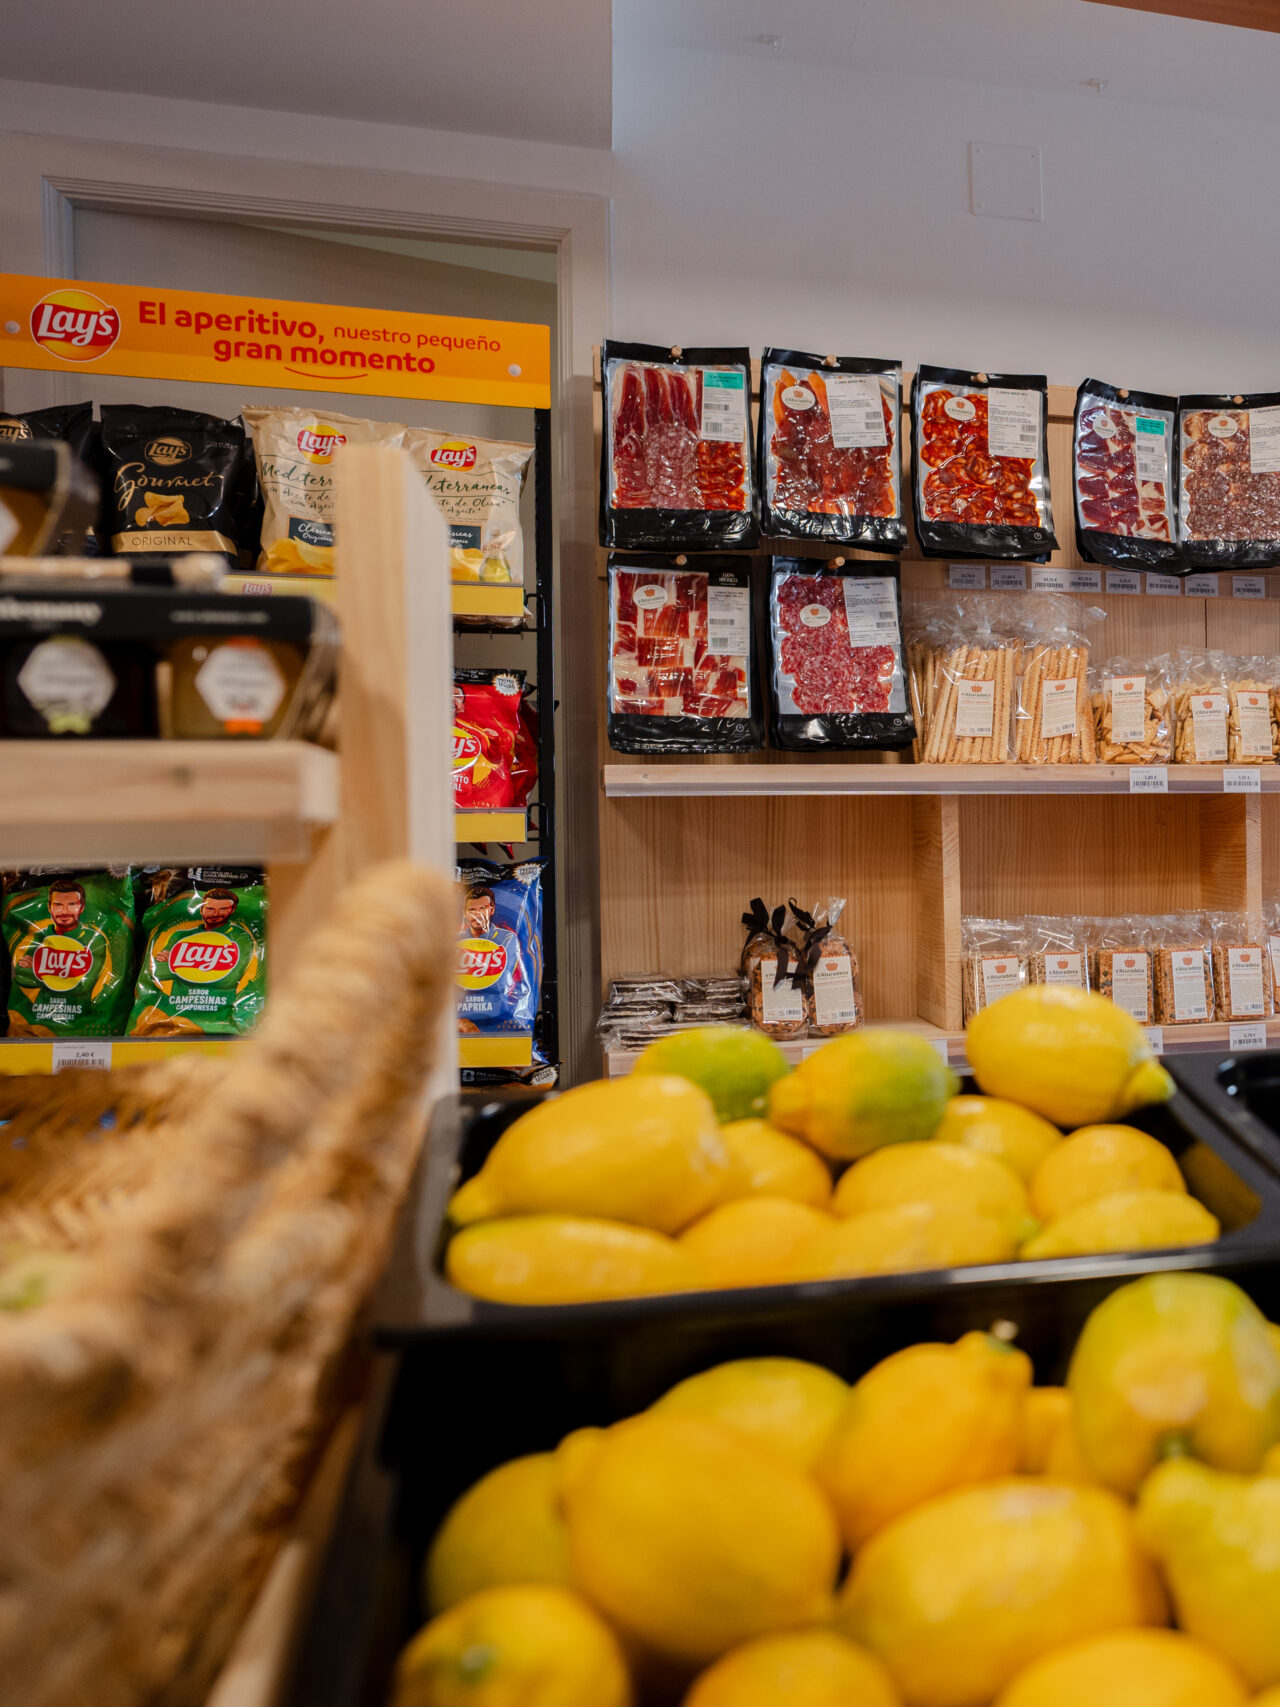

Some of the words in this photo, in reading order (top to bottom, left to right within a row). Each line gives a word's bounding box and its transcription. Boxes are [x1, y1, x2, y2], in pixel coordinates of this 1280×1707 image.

[37, 304, 115, 346] Lay's
[138, 300, 166, 326] El
[174, 308, 325, 344] aperitivo,
[333, 326, 411, 344] nuestro
[416, 332, 501, 351] pequeño
[213, 339, 282, 362] gran
[290, 345, 436, 374] momento
[147, 441, 189, 462] Lay's
[299, 430, 345, 457] Lay's
[433, 446, 475, 468] Lay's
[260, 462, 334, 487] Mediterr
[113, 462, 225, 512] Gourmet
[131, 536, 194, 546] ORIGINAL
[38, 947, 89, 979] Lay's
[173, 942, 236, 972] Lay's
[168, 995, 228, 1005] CAMPESINAS
[188, 988, 210, 996] SABOR
[31, 1003, 82, 1014] CAMPESINAS
[175, 1004, 219, 1012] CAMPONESAS
[457, 1002, 493, 1012] PAPRIKA
